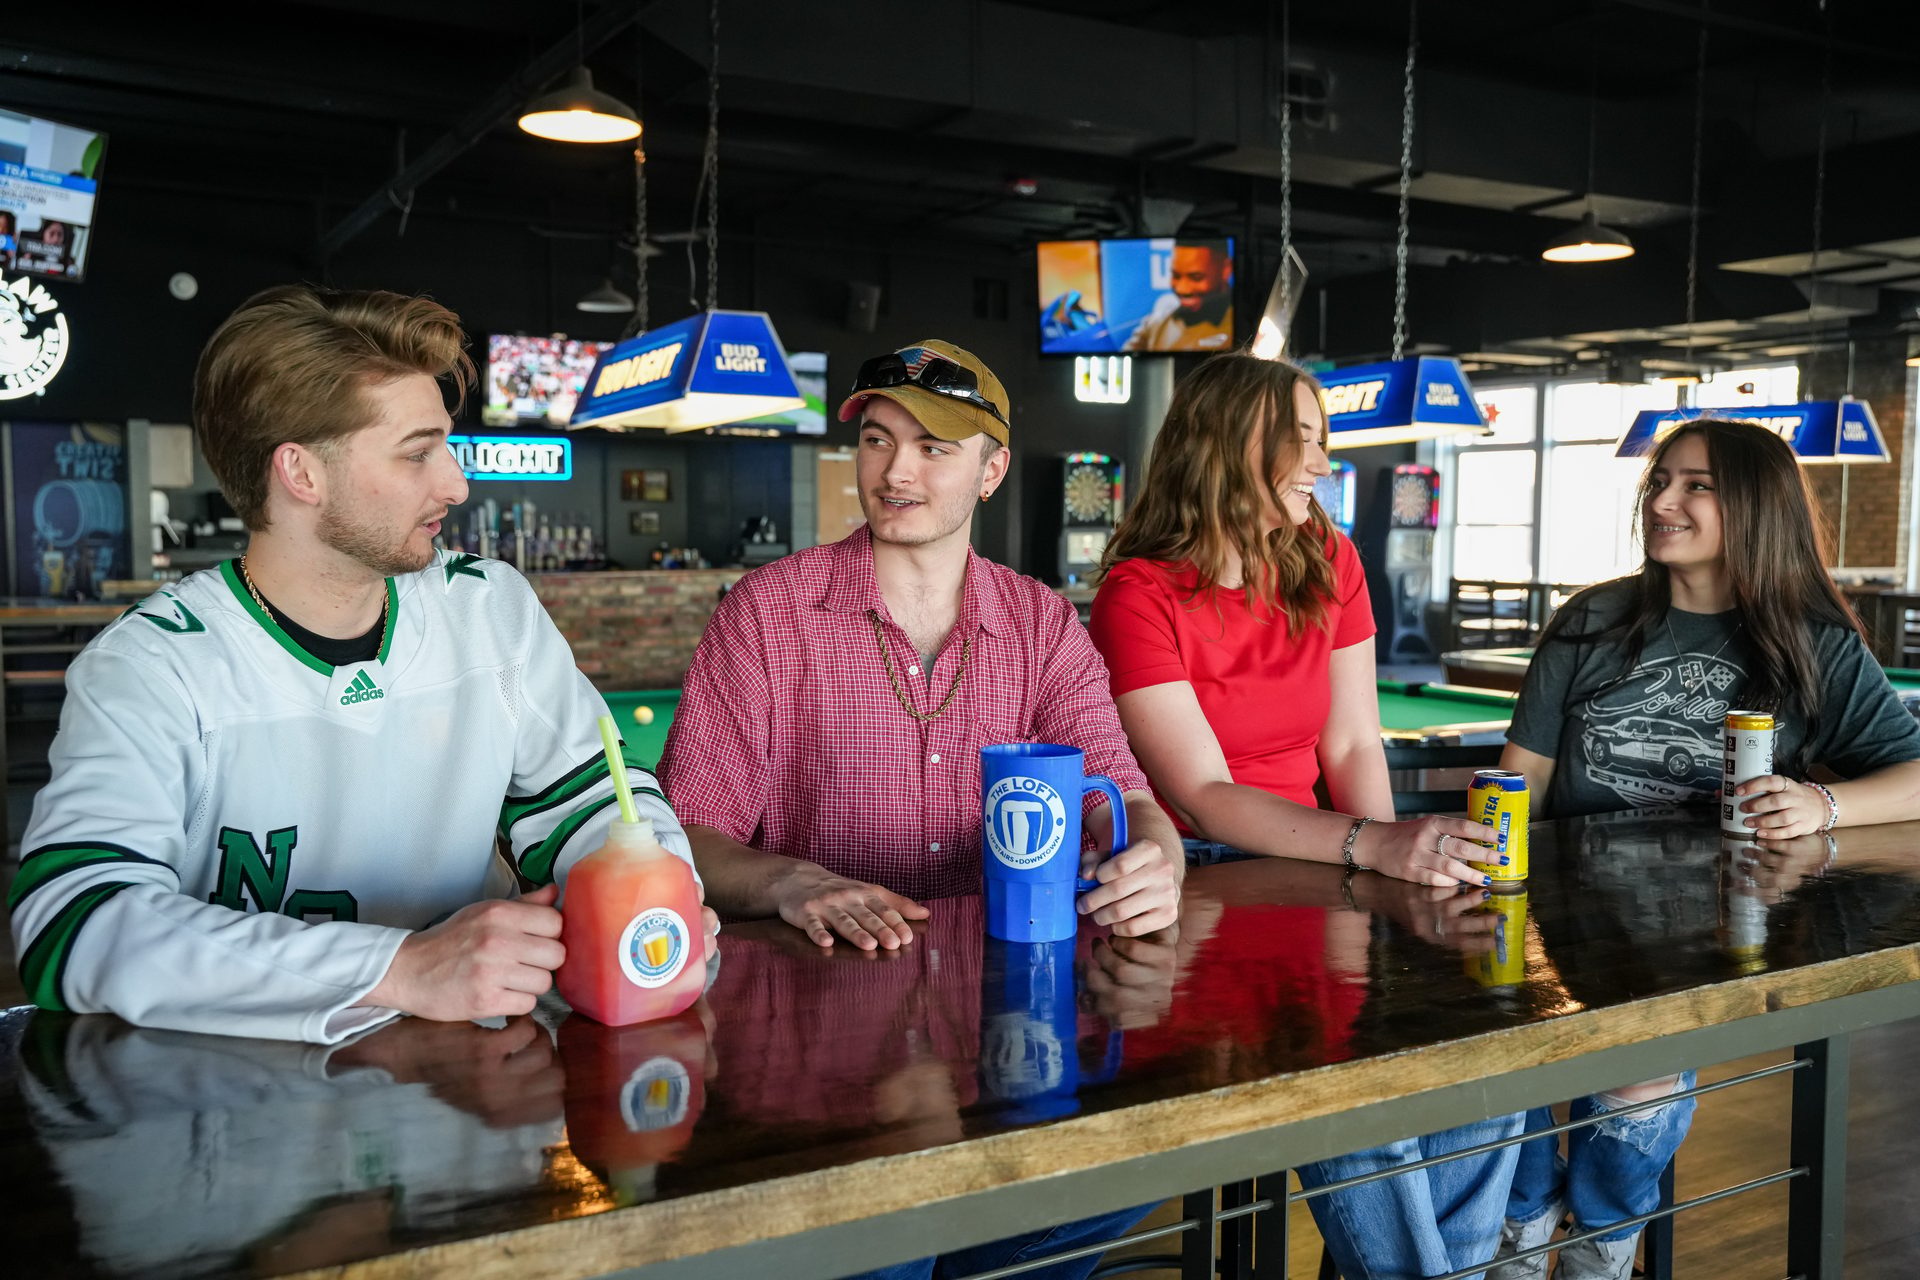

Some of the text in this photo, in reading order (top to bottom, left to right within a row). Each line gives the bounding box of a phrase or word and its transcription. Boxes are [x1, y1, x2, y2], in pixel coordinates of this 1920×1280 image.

[721, 343, 759, 358] BUD
[715, 356, 767, 373] LIGHT
[1320, 380, 1385, 416] IGHT
[457, 442, 563, 473] LIGHT
[340, 688, 384, 705] adidas
[990, 778, 1058, 802] THE LOFT
[1484, 795, 1500, 816] TEA
[989, 833, 1061, 865] UPSTAIRS DOWNTOWN
[634, 917, 674, 941] THE LOFT
